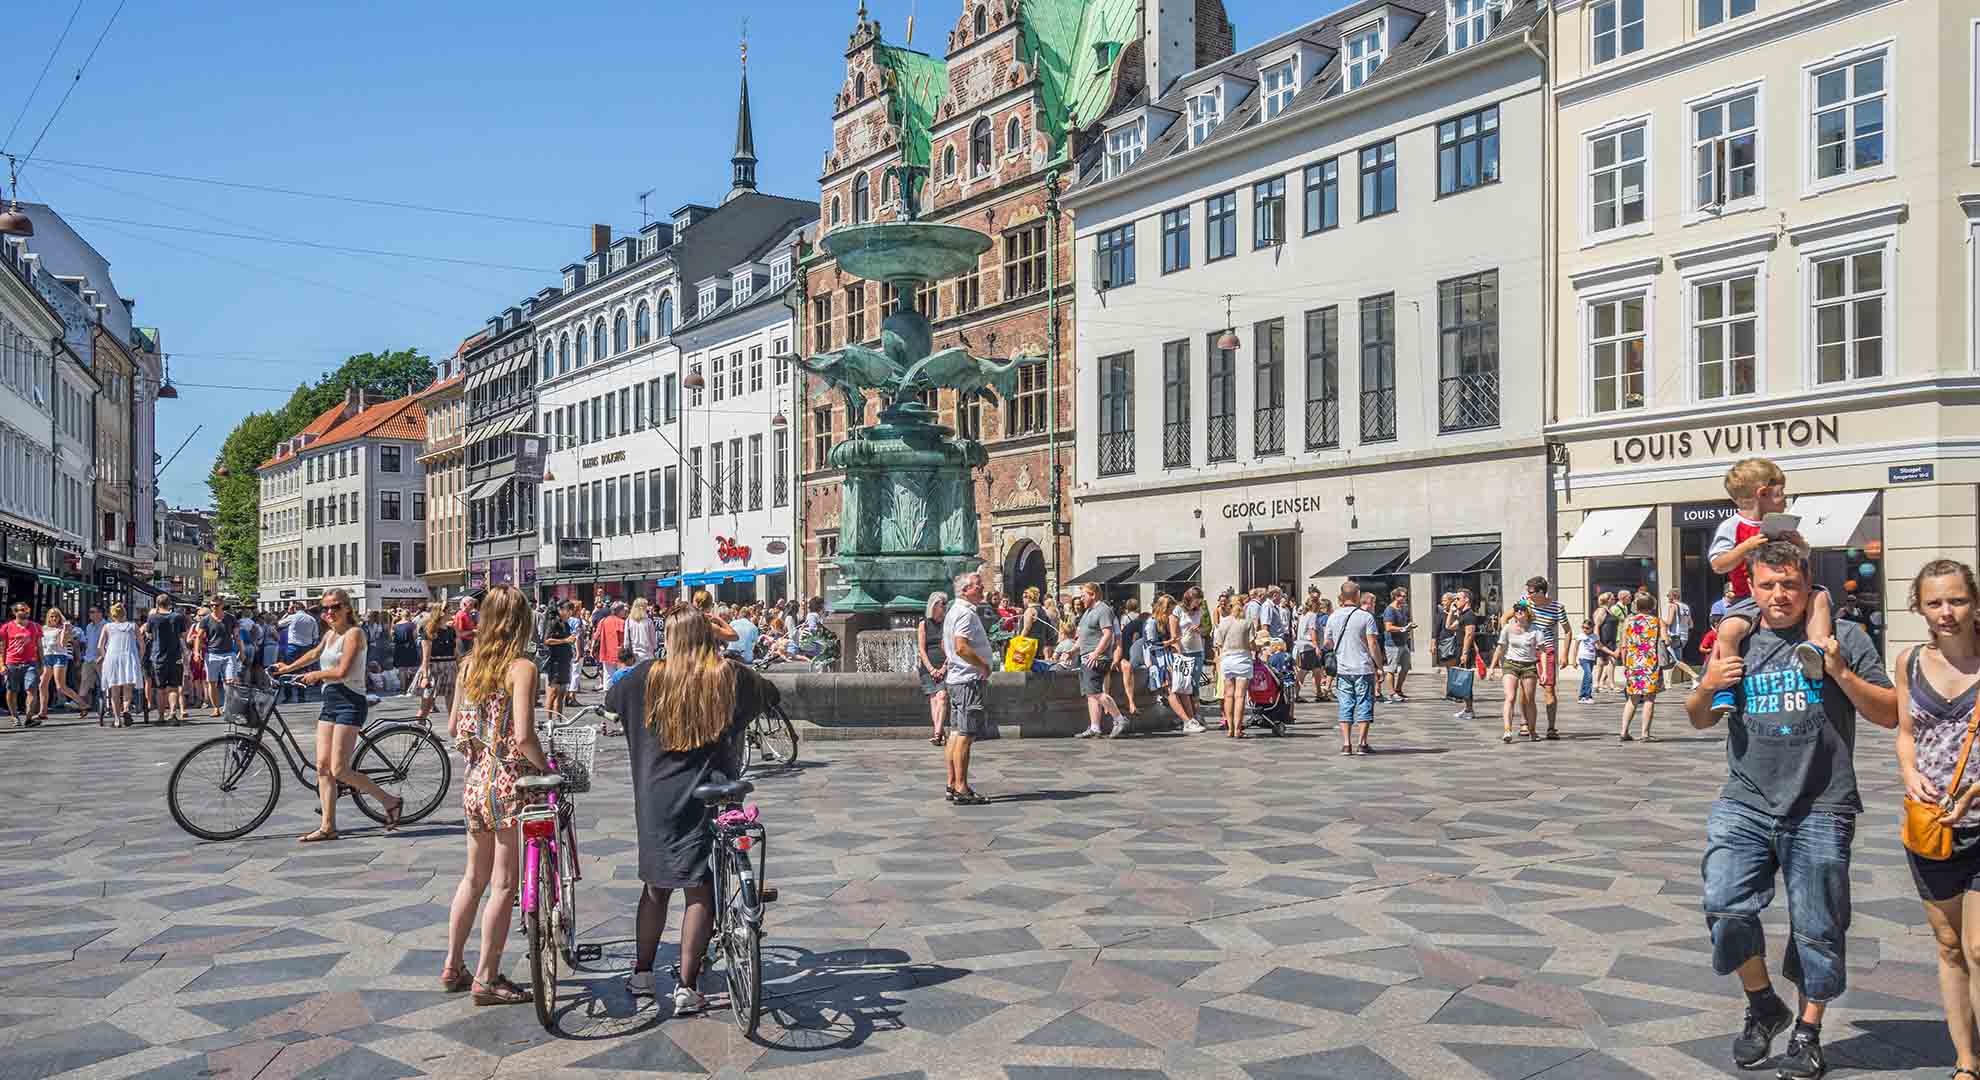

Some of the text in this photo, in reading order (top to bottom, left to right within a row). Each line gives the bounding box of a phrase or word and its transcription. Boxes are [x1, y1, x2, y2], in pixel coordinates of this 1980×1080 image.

[1614, 416, 1839, 464] LOUIS VUITTON
[1222, 496, 1320, 518] GEORG JENSEN
[1684, 508, 1740, 521] LOUIS VUI
[1784, 692, 1806, 712] 66
